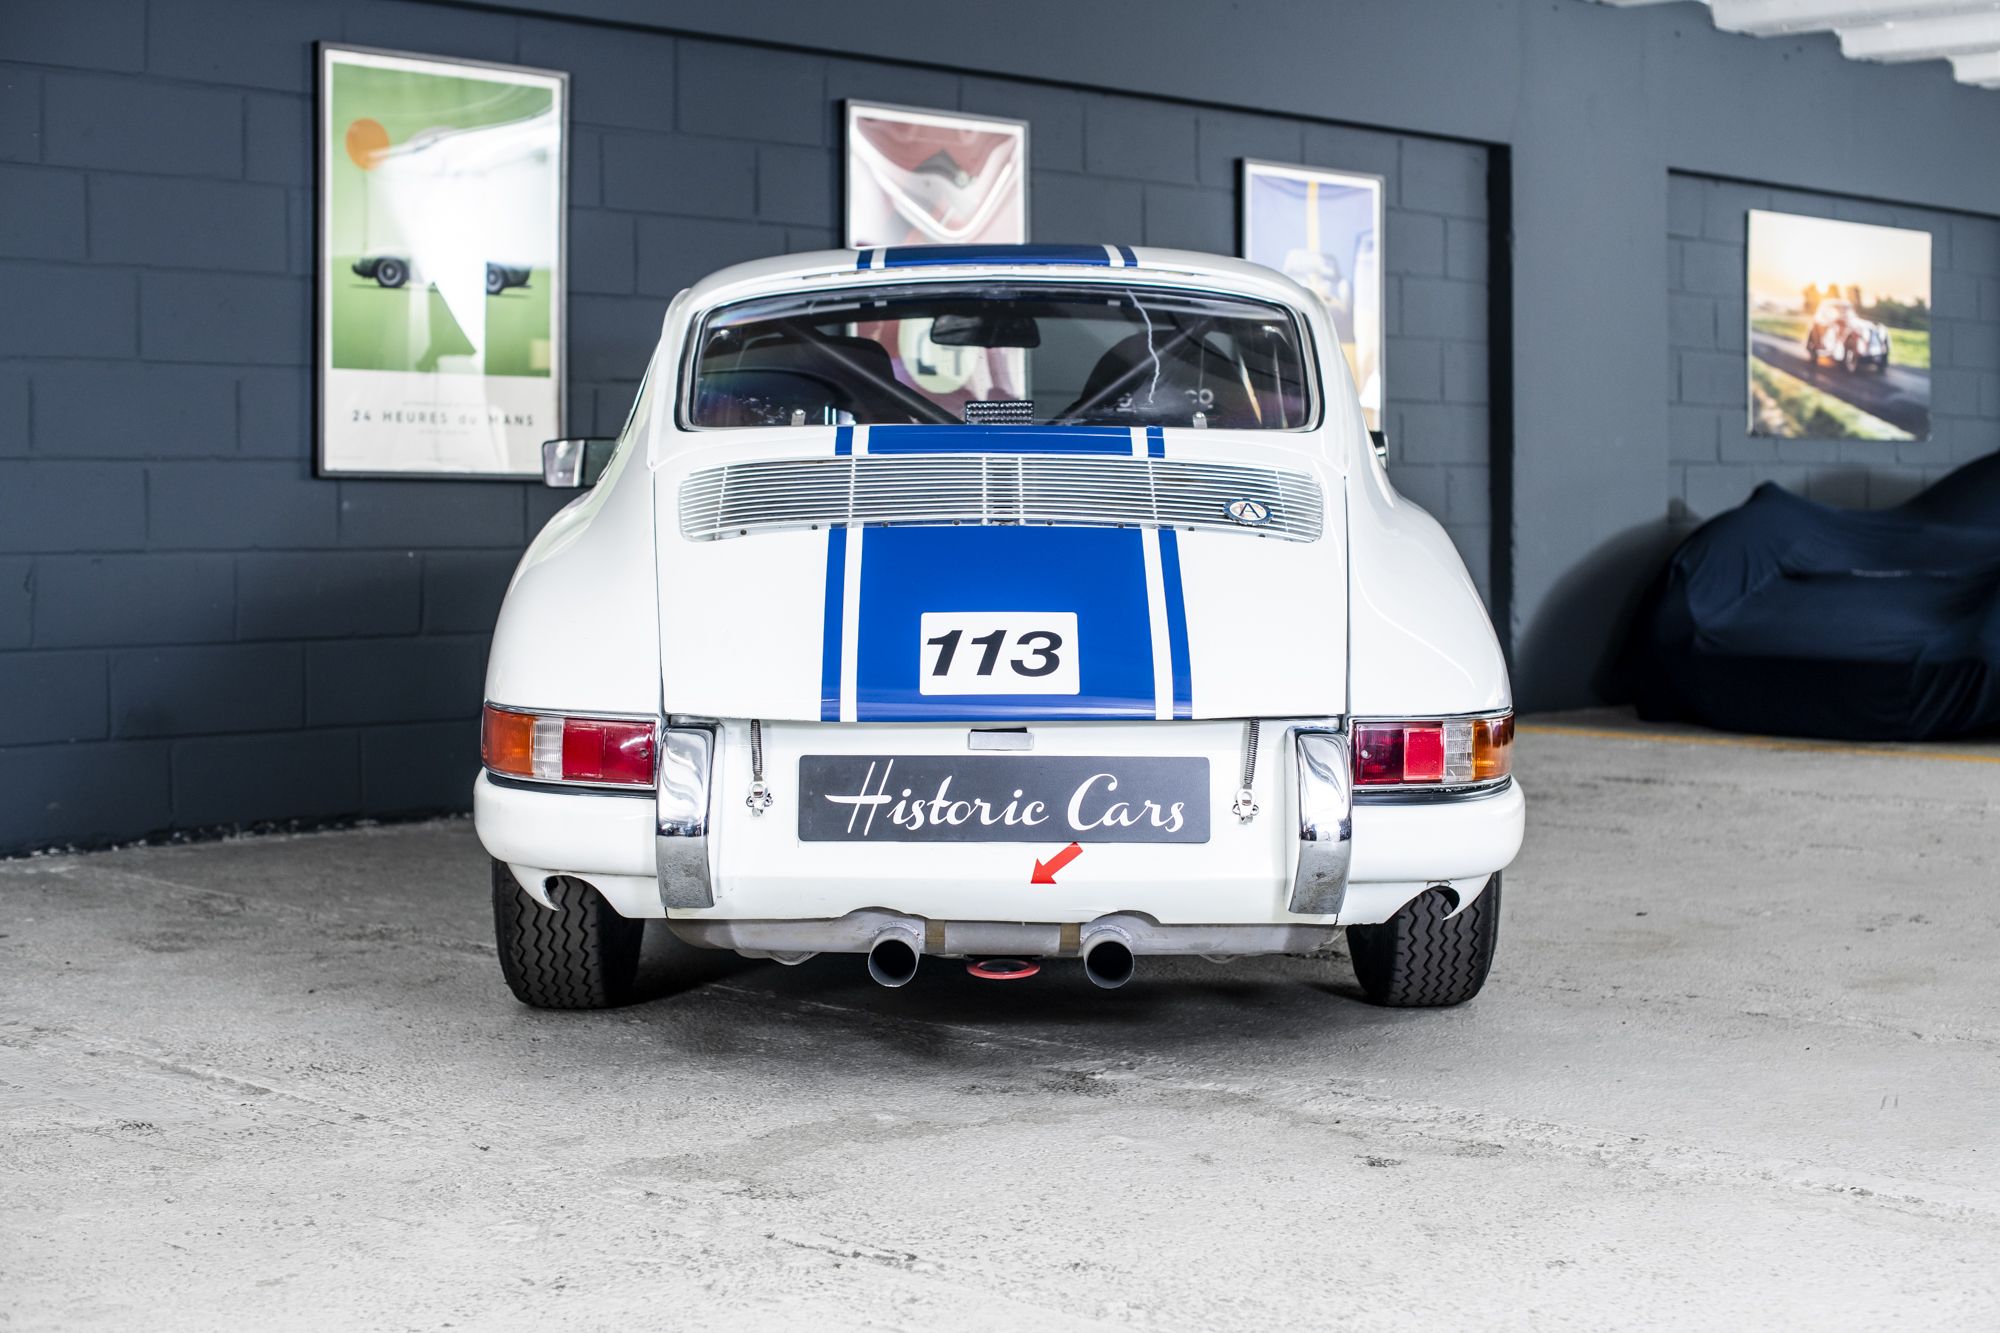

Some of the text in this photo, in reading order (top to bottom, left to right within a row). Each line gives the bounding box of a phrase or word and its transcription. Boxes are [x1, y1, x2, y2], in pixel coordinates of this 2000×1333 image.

[352, 409, 371, 422] 24
[382, 410, 448, 425] HEURES
[927, 630, 1063, 677] 113
[824, 758, 1184, 836] Historic Cars
